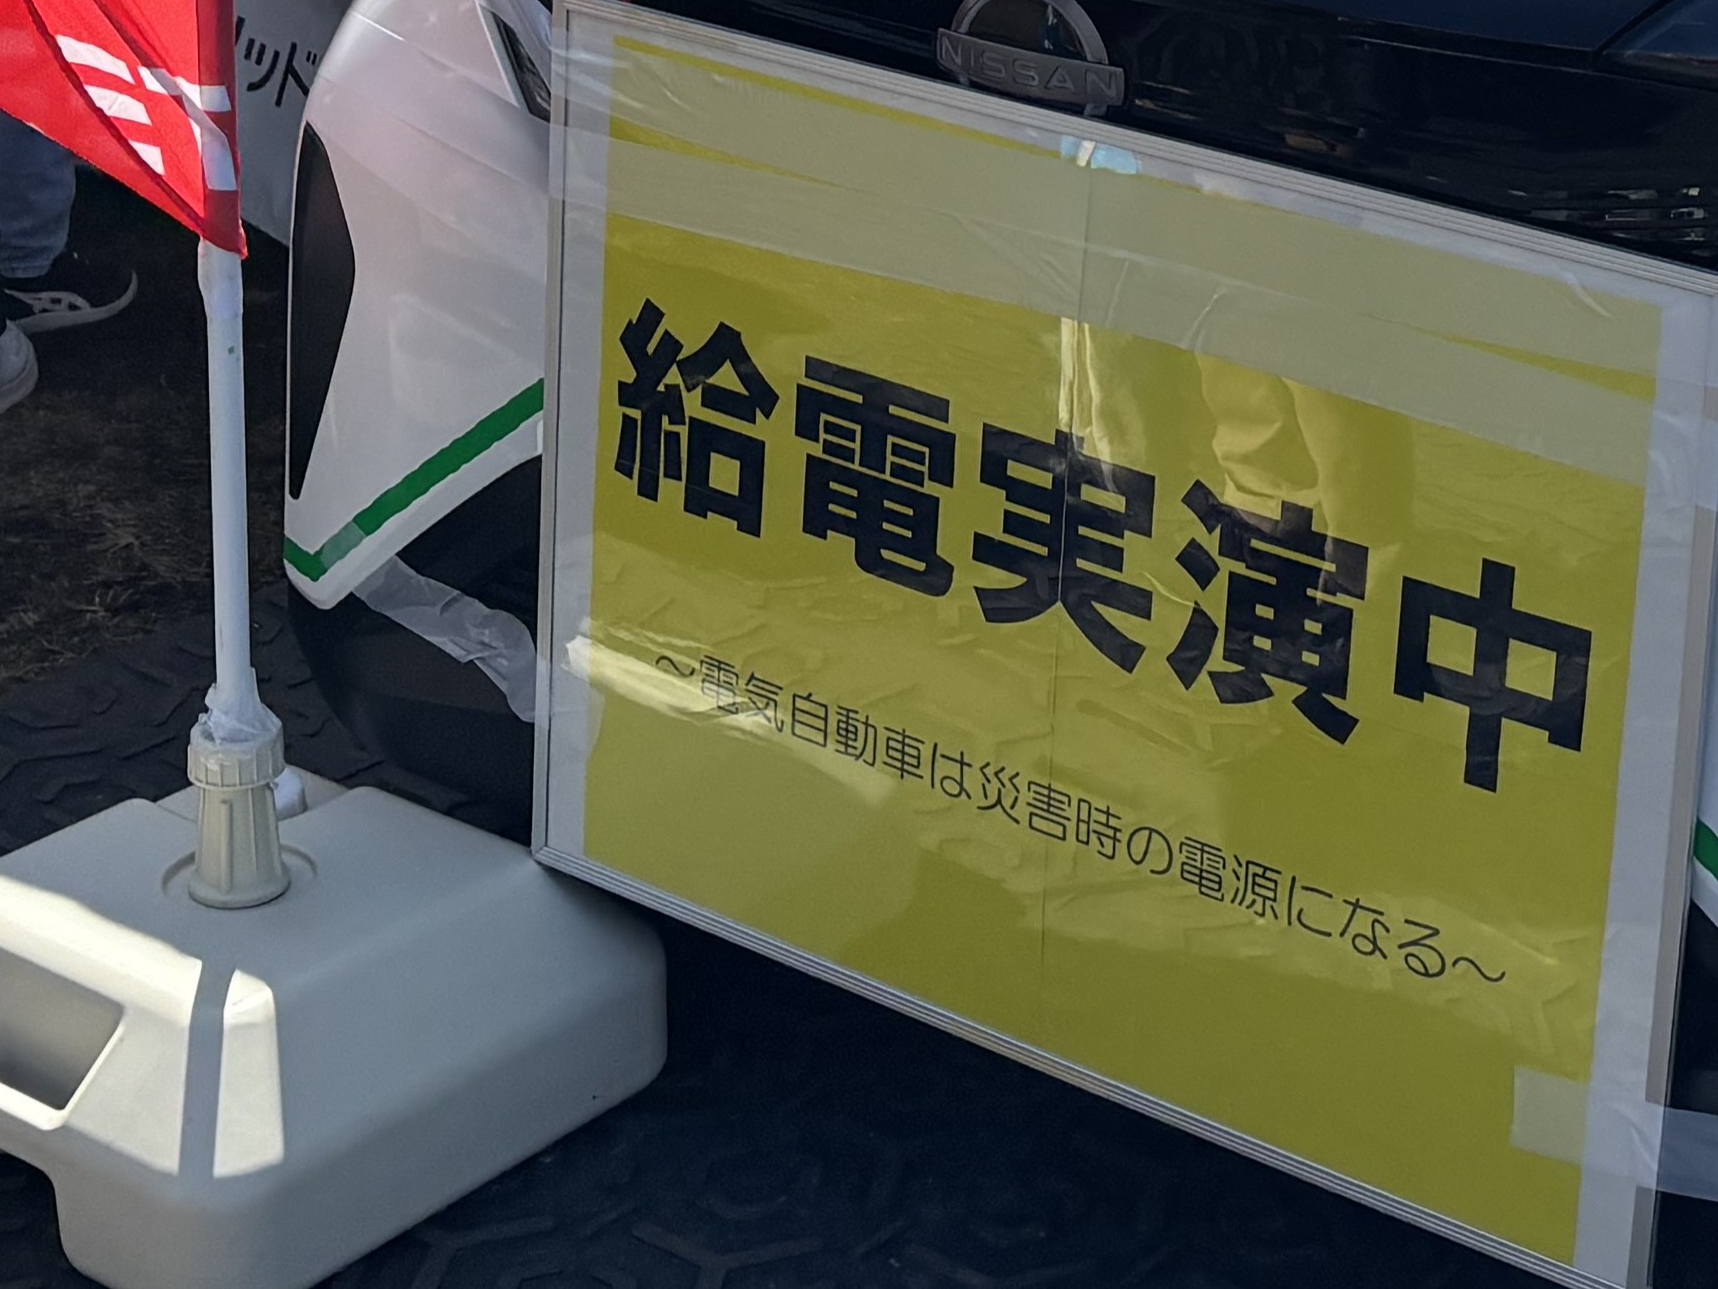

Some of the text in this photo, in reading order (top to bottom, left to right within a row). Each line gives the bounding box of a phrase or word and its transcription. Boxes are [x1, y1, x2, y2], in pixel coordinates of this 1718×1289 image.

[941, 35, 1118, 98] NISSAN
[613, 298, 1593, 793] 給電実演中
